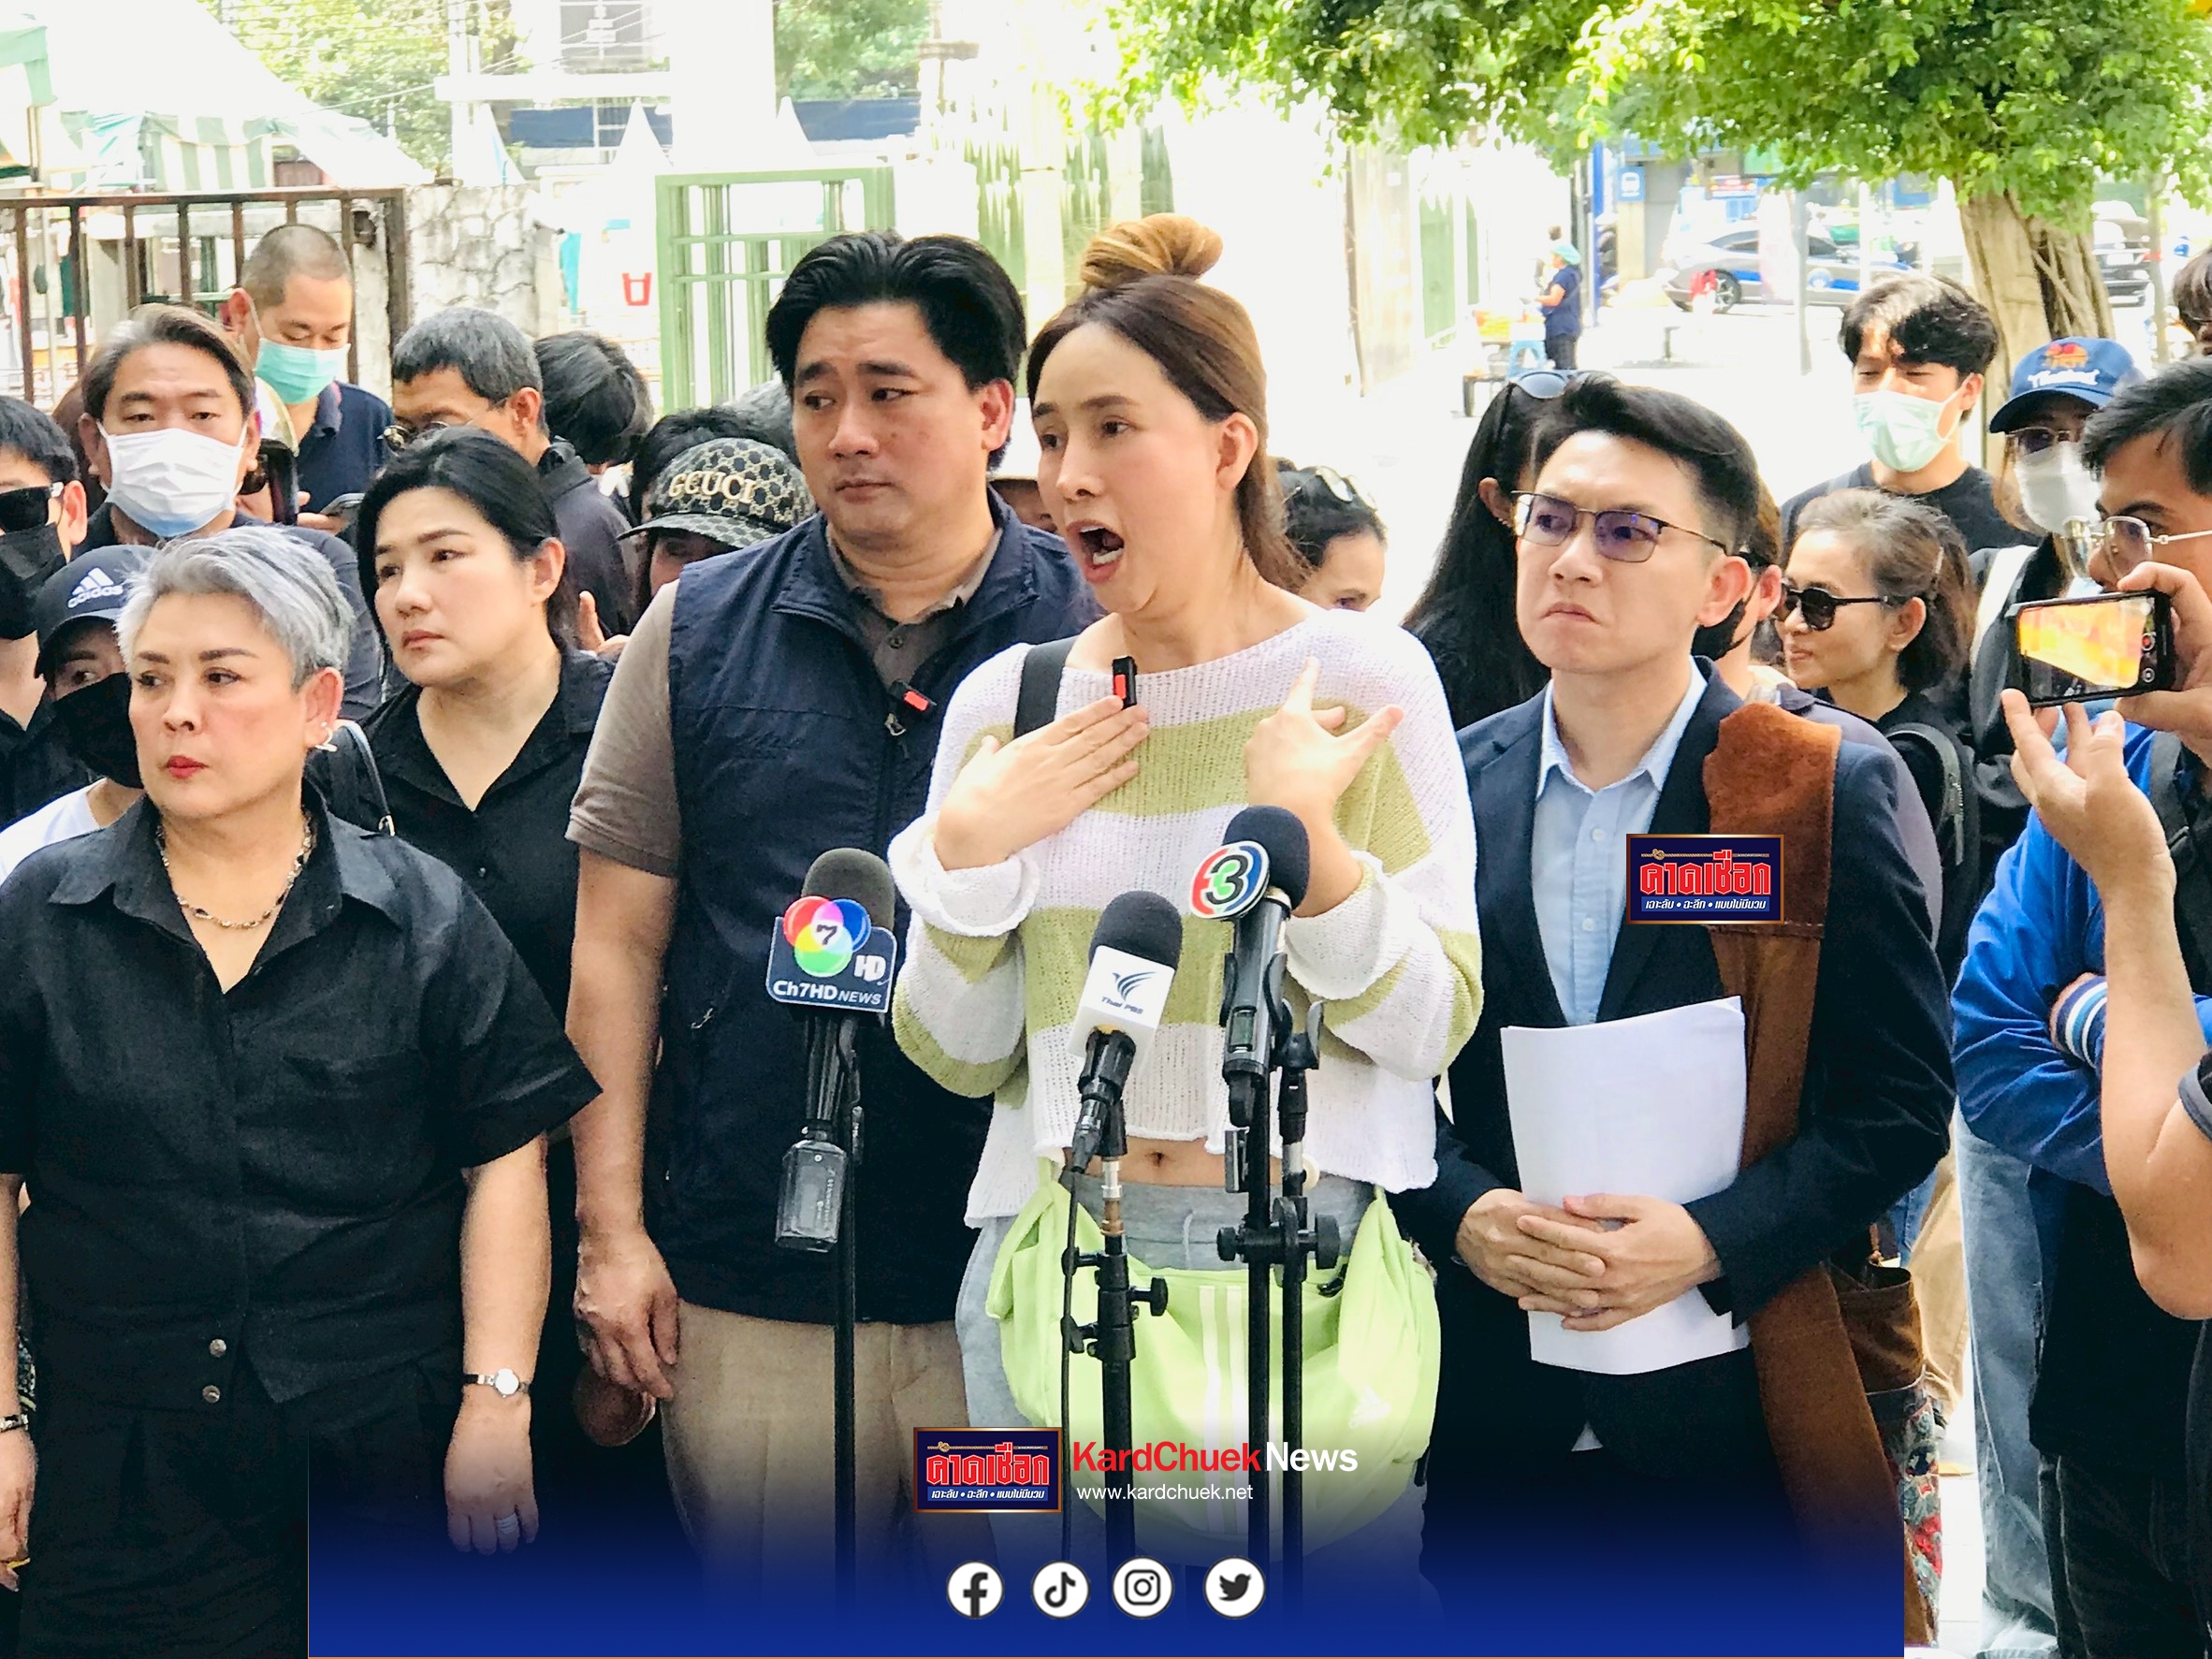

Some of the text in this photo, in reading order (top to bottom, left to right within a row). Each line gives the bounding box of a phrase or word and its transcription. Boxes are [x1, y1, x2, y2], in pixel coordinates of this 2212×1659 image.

[1205, 854, 1249, 905] 3
[816, 924, 837, 945] 7
[853, 954, 886, 982] HD
[773, 980, 881, 1005] Ch7HD NEWS
